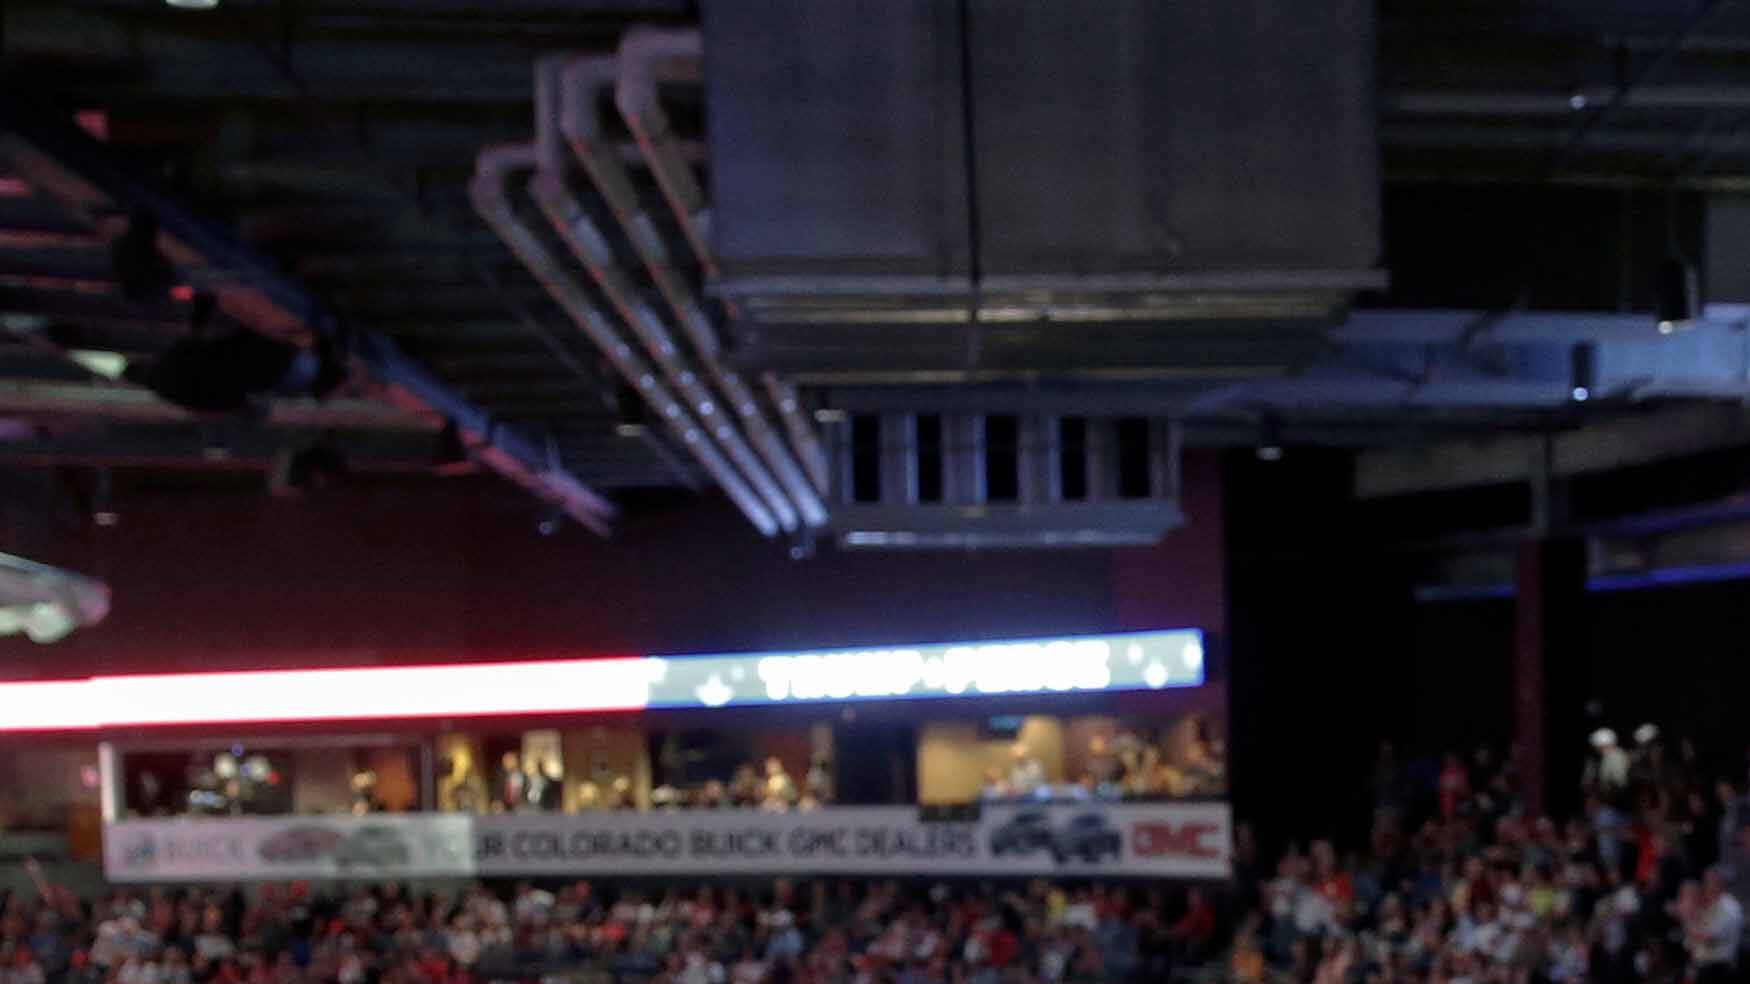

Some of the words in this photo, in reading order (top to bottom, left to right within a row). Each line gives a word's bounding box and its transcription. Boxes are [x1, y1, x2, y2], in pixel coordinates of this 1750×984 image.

[163, 834, 247, 863] BUICK
[509, 829, 681, 859] COLORADO
[689, 828, 778, 858] BUICK
[788, 827, 847, 857] GMC
[854, 826, 975, 858] DEALERS
[1131, 821, 1219, 857] GMC
